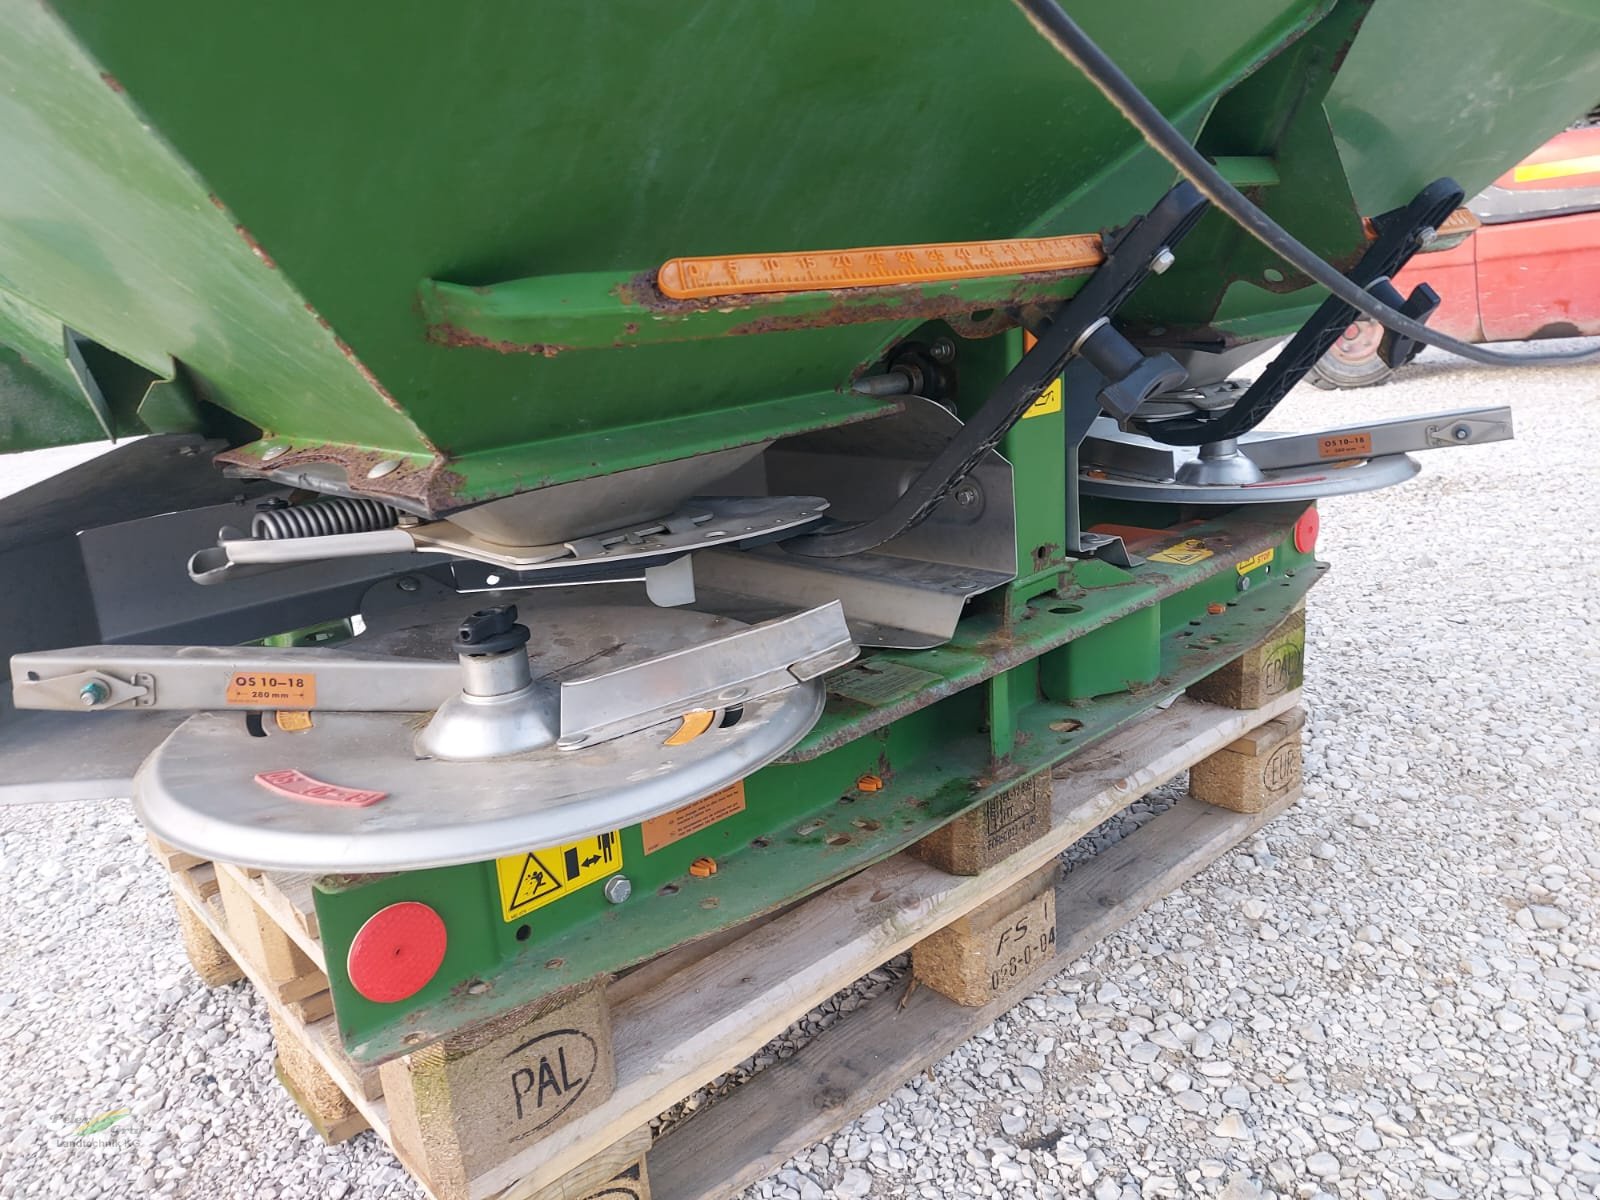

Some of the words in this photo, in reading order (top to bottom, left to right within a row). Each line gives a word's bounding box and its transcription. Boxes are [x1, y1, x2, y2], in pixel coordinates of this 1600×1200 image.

[726, 260, 738, 272] 5
[762, 258, 780, 271] 10
[800, 256, 817, 269] 15
[833, 255, 852, 267] 20
[235, 676, 257, 687] OS
[260, 677, 304, 688] 10-18
[251, 691, 270, 699] 280
[996, 915, 1029, 957] FS
[511, 1046, 583, 1120] PAL
